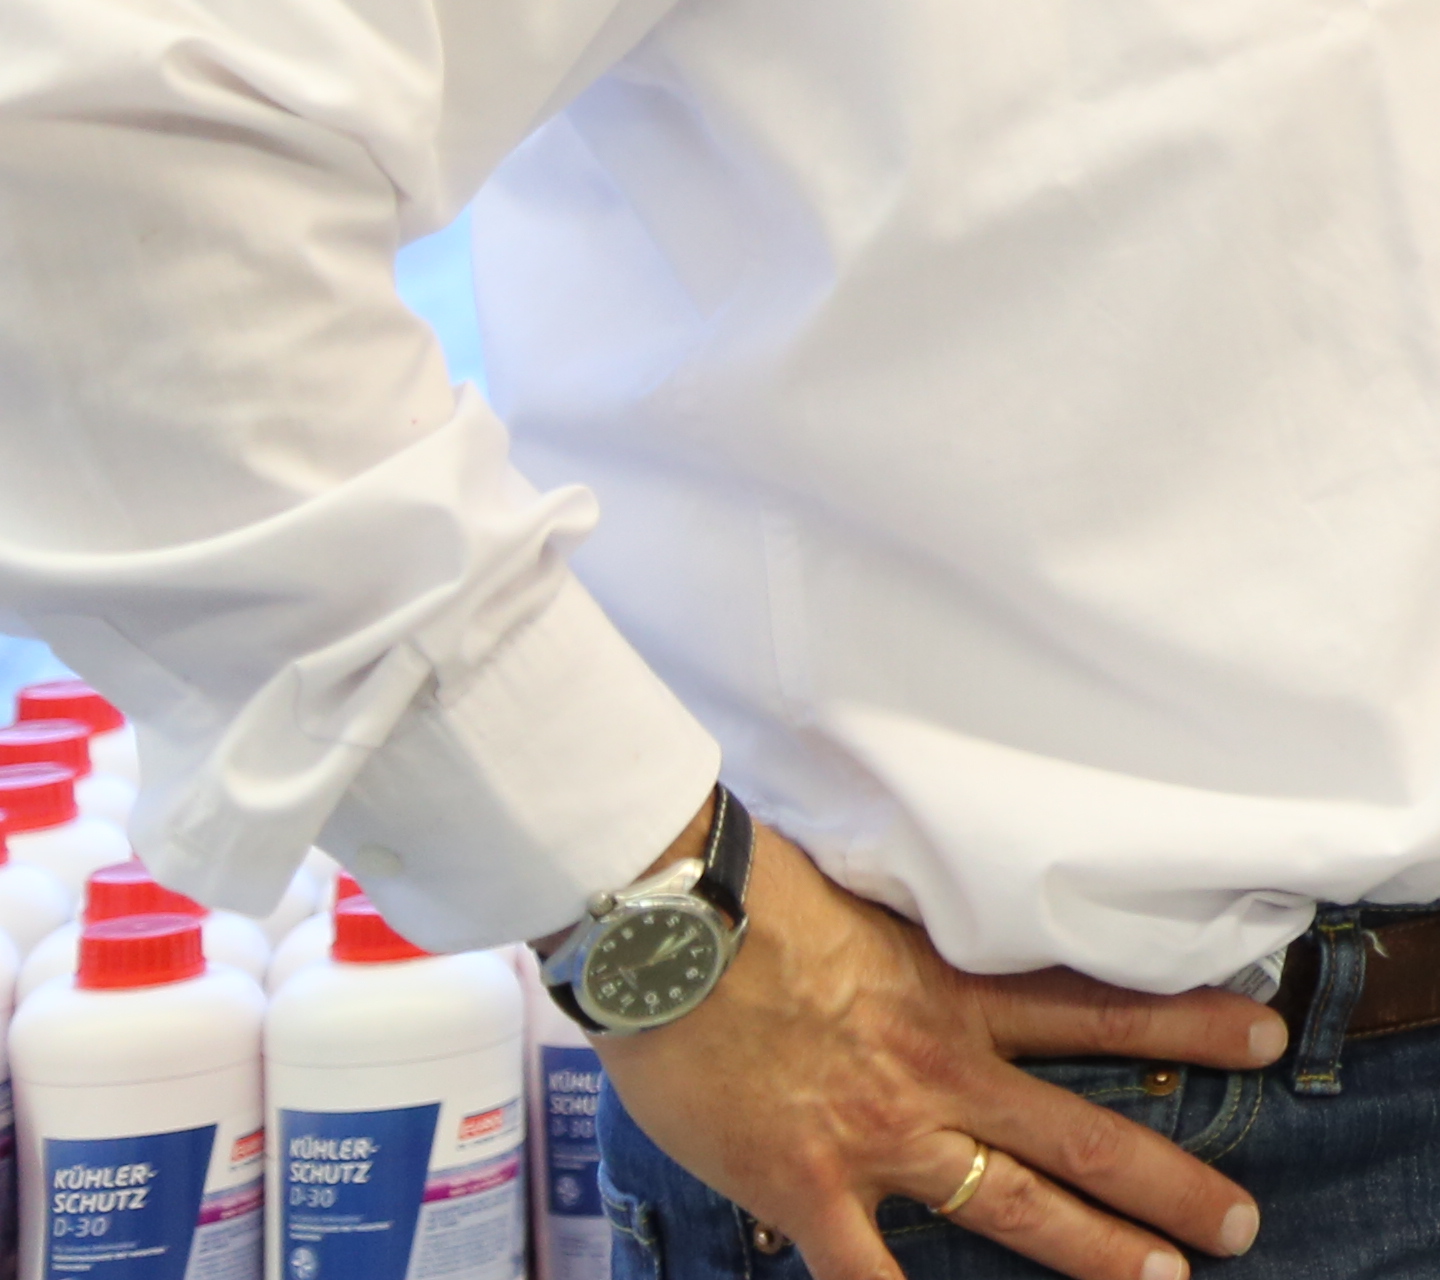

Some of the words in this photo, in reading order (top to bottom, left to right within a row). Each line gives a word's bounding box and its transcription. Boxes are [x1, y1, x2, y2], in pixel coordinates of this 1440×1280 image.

[289, 1134, 381, 1161] KÜHLER-
[53, 1162, 159, 1190] KÜHLER-
[289, 1159, 374, 1185] SCHUTZ
[52, 1187, 150, 1215] SCHUTZ
[289, 1185, 337, 1209] D-30
[53, 1215, 111, 1239] D-30
